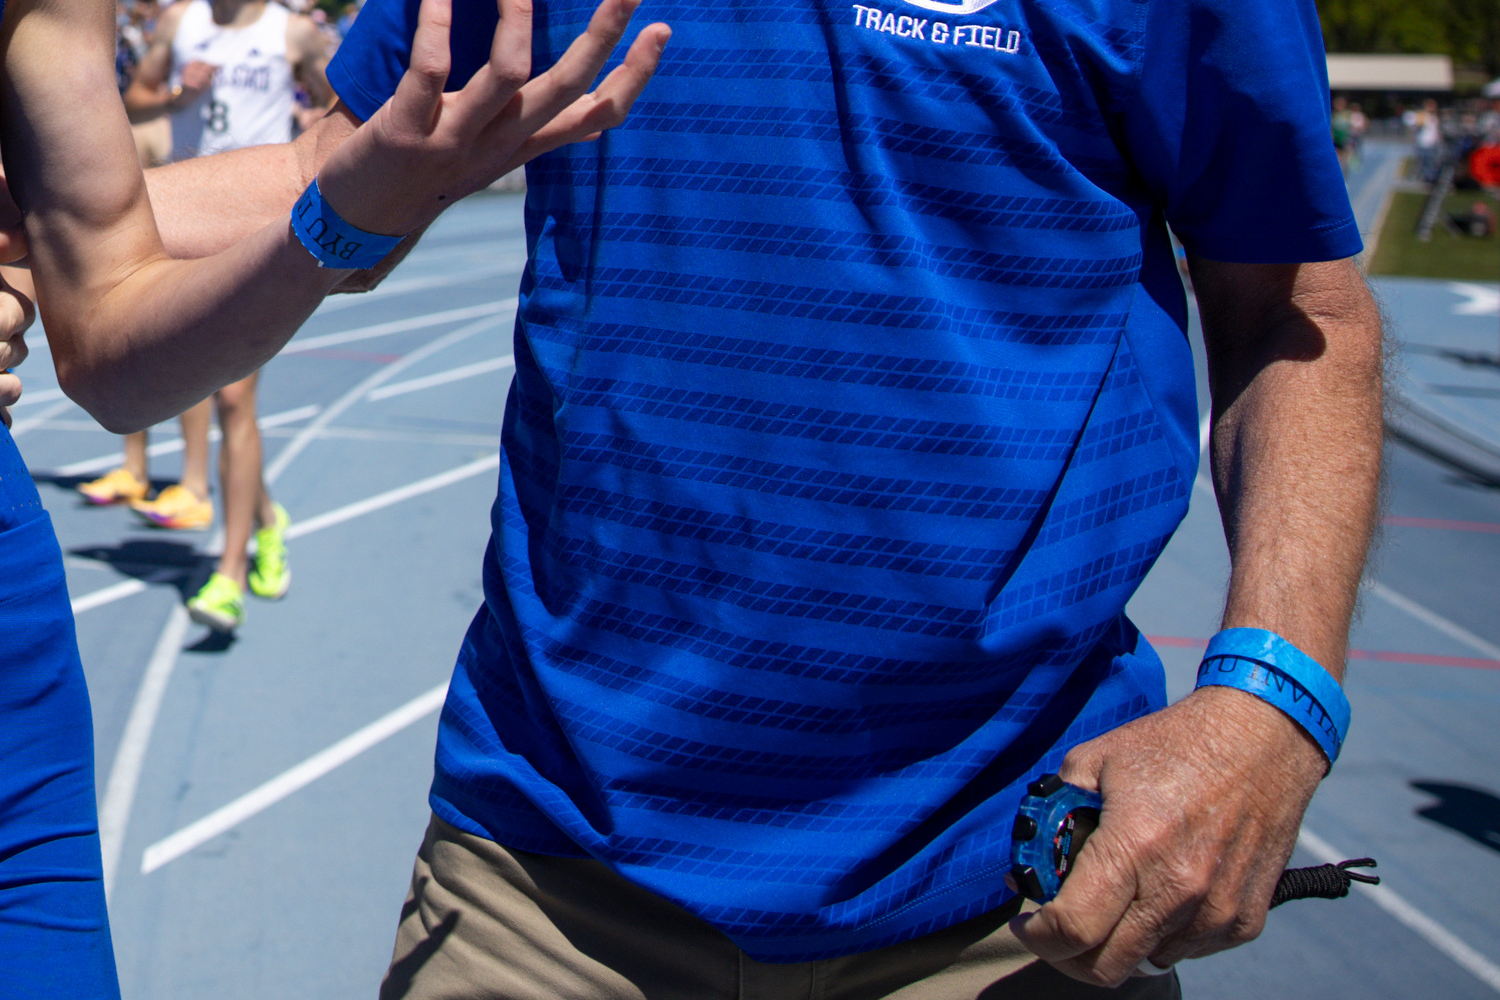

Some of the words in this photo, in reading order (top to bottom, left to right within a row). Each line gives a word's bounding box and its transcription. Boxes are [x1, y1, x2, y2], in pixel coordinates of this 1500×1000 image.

[853, 4, 927, 40] TRACK
[931, 22, 949, 44] &
[953, 25, 1020, 54] FIELD
[305, 217, 364, 260] BYU
